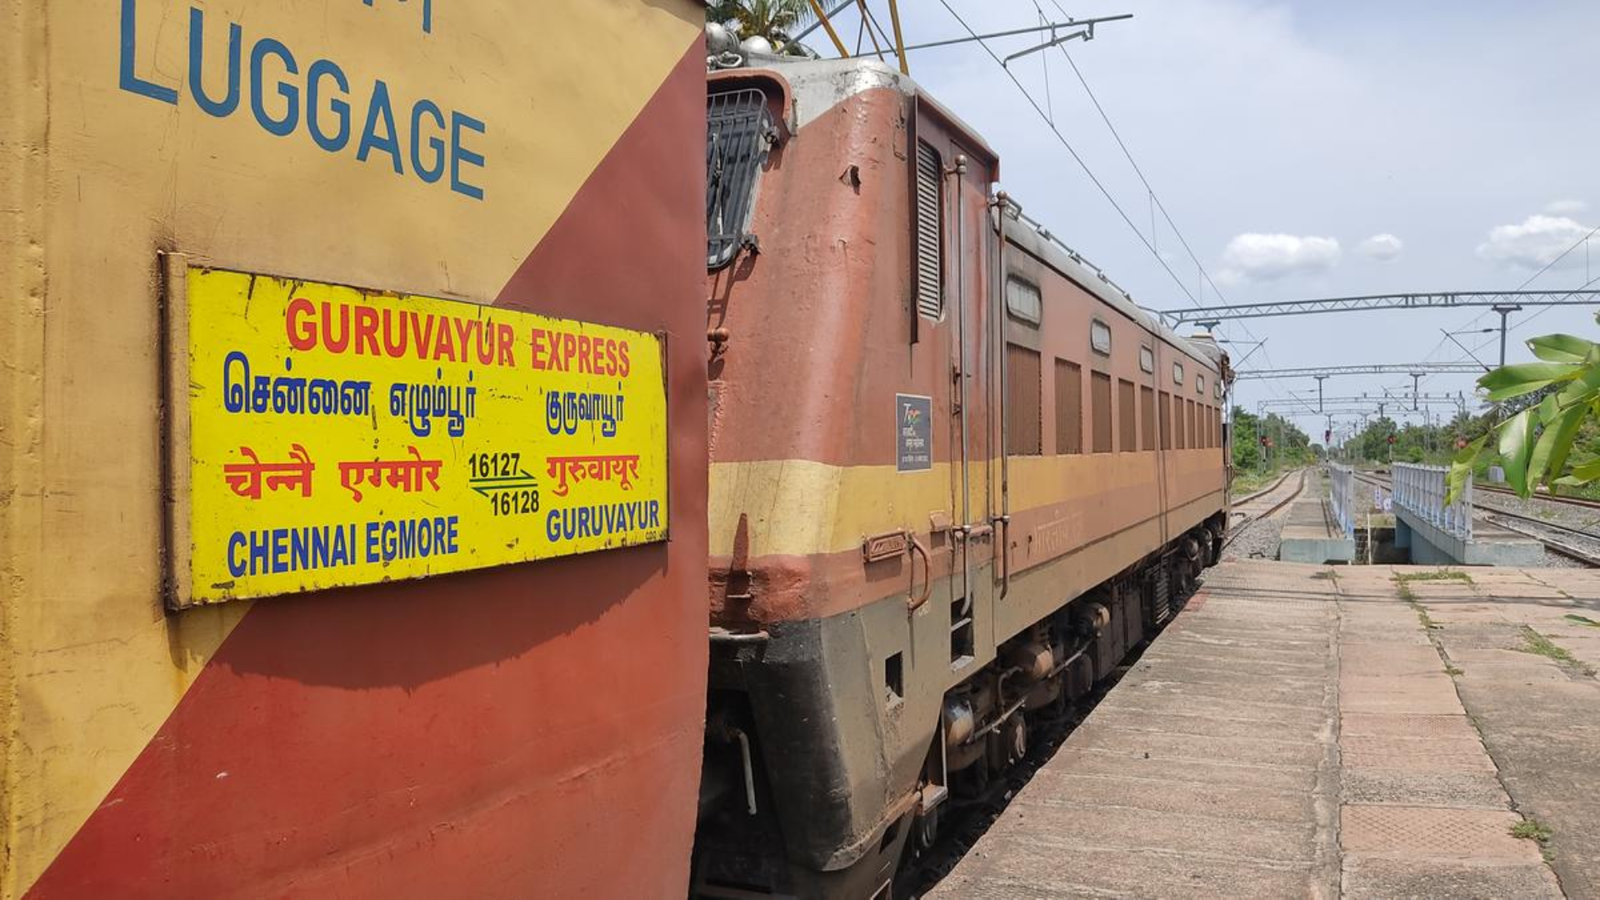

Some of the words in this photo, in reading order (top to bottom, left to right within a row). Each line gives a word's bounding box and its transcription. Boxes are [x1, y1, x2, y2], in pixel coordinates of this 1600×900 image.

[119, 0, 486, 201] LUGGAGE
[285, 298, 515, 367] GURUVAYUR
[531, 328, 631, 378] EXPRESS
[223, 350, 372, 415] சென்னை
[389, 367, 477, 437] எழும்பூர்
[546, 381, 624, 437] குருவாயூர்
[223, 443, 315, 500] चेन्नै
[338, 445, 443, 502] एग्मोर
[468, 453, 520, 478] 16127
[546, 454, 640, 497] गुरुवायूर
[491, 490, 540, 516] 16128
[546, 500, 660, 542] GURUVAYUR
[227, 524, 357, 578] CHENNAI
[365, 515, 459, 564] EGMORE
